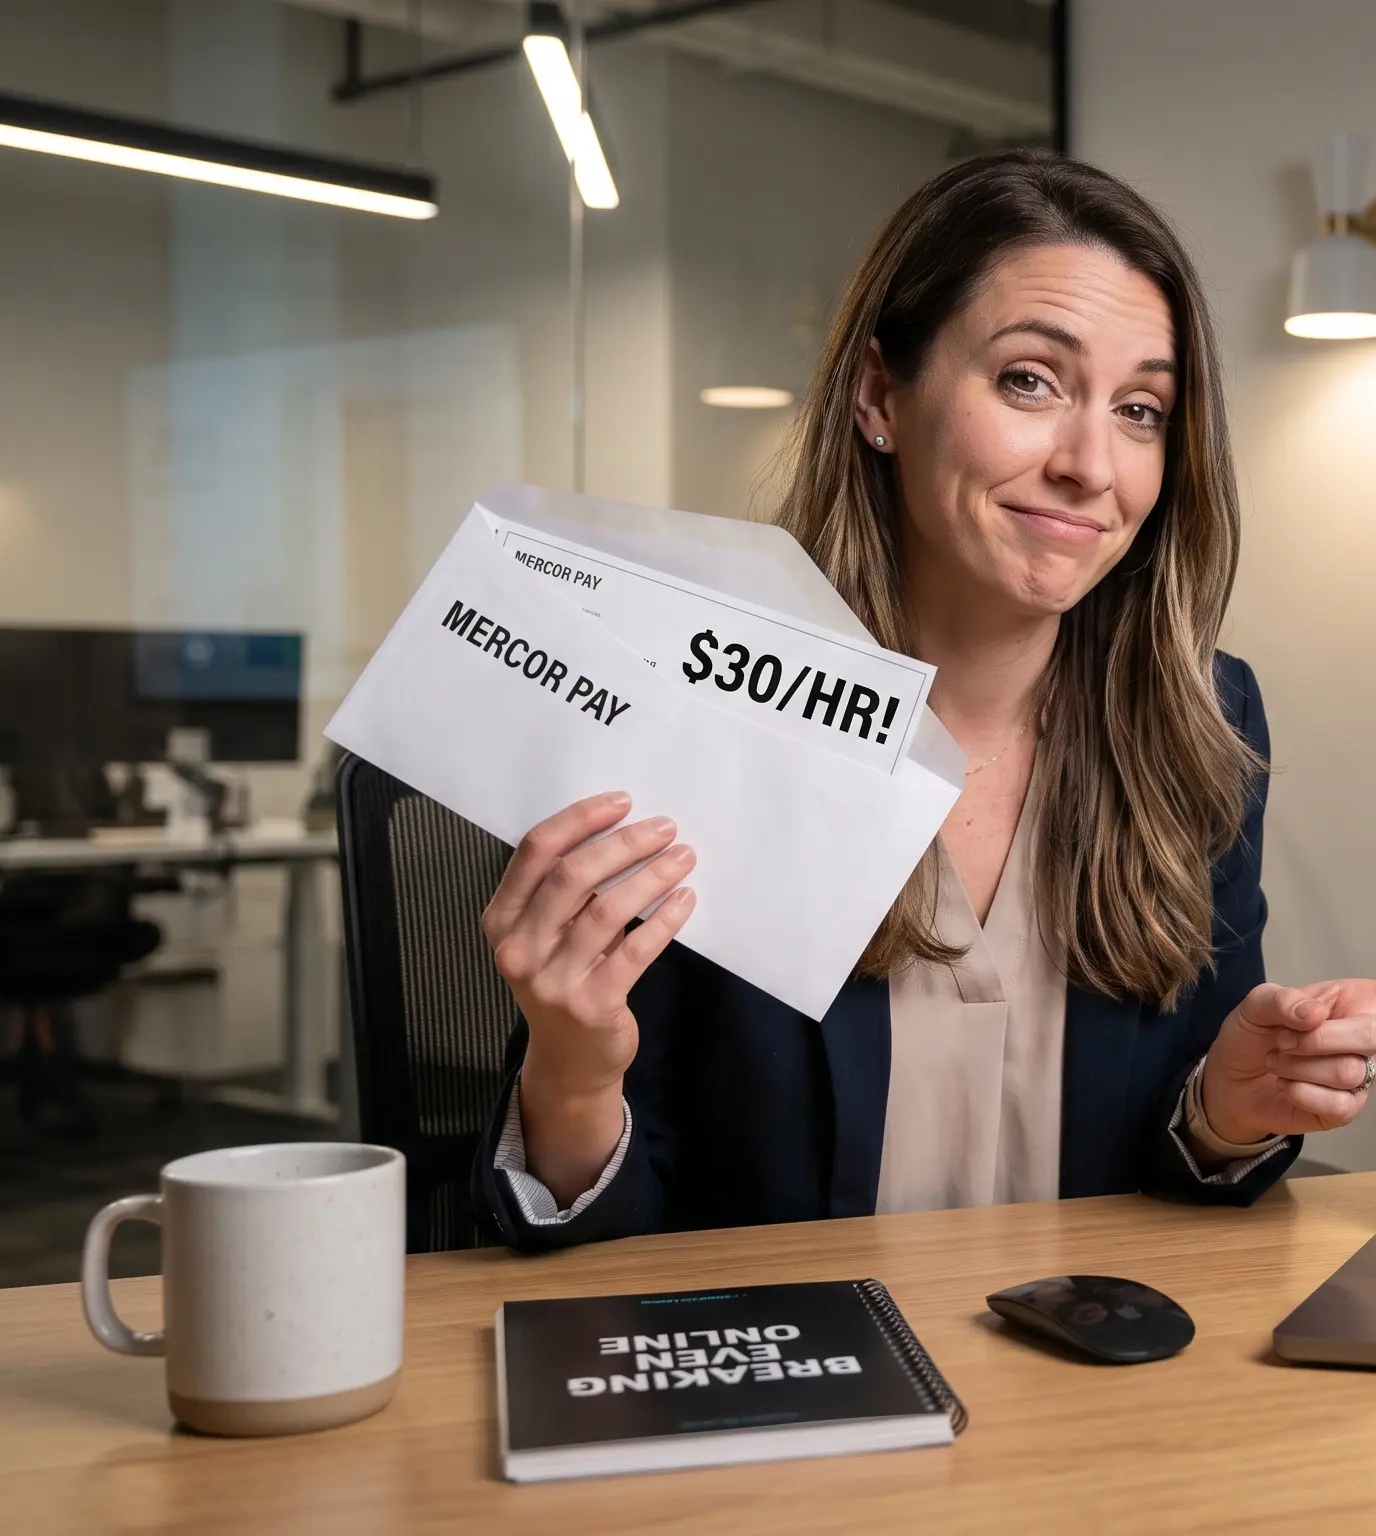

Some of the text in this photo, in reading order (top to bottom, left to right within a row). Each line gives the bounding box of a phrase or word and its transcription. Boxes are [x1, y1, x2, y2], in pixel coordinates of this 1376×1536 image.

[514, 550, 603, 590] MERCOR PAY
[441, 599, 632, 727] MERCOR PAY
[682, 628, 900, 746] $30/HR!
[599, 1324, 800, 1355] ONLINE
[637, 1343, 781, 1371] EVEN
[568, 1355, 862, 1396] BREAKING
